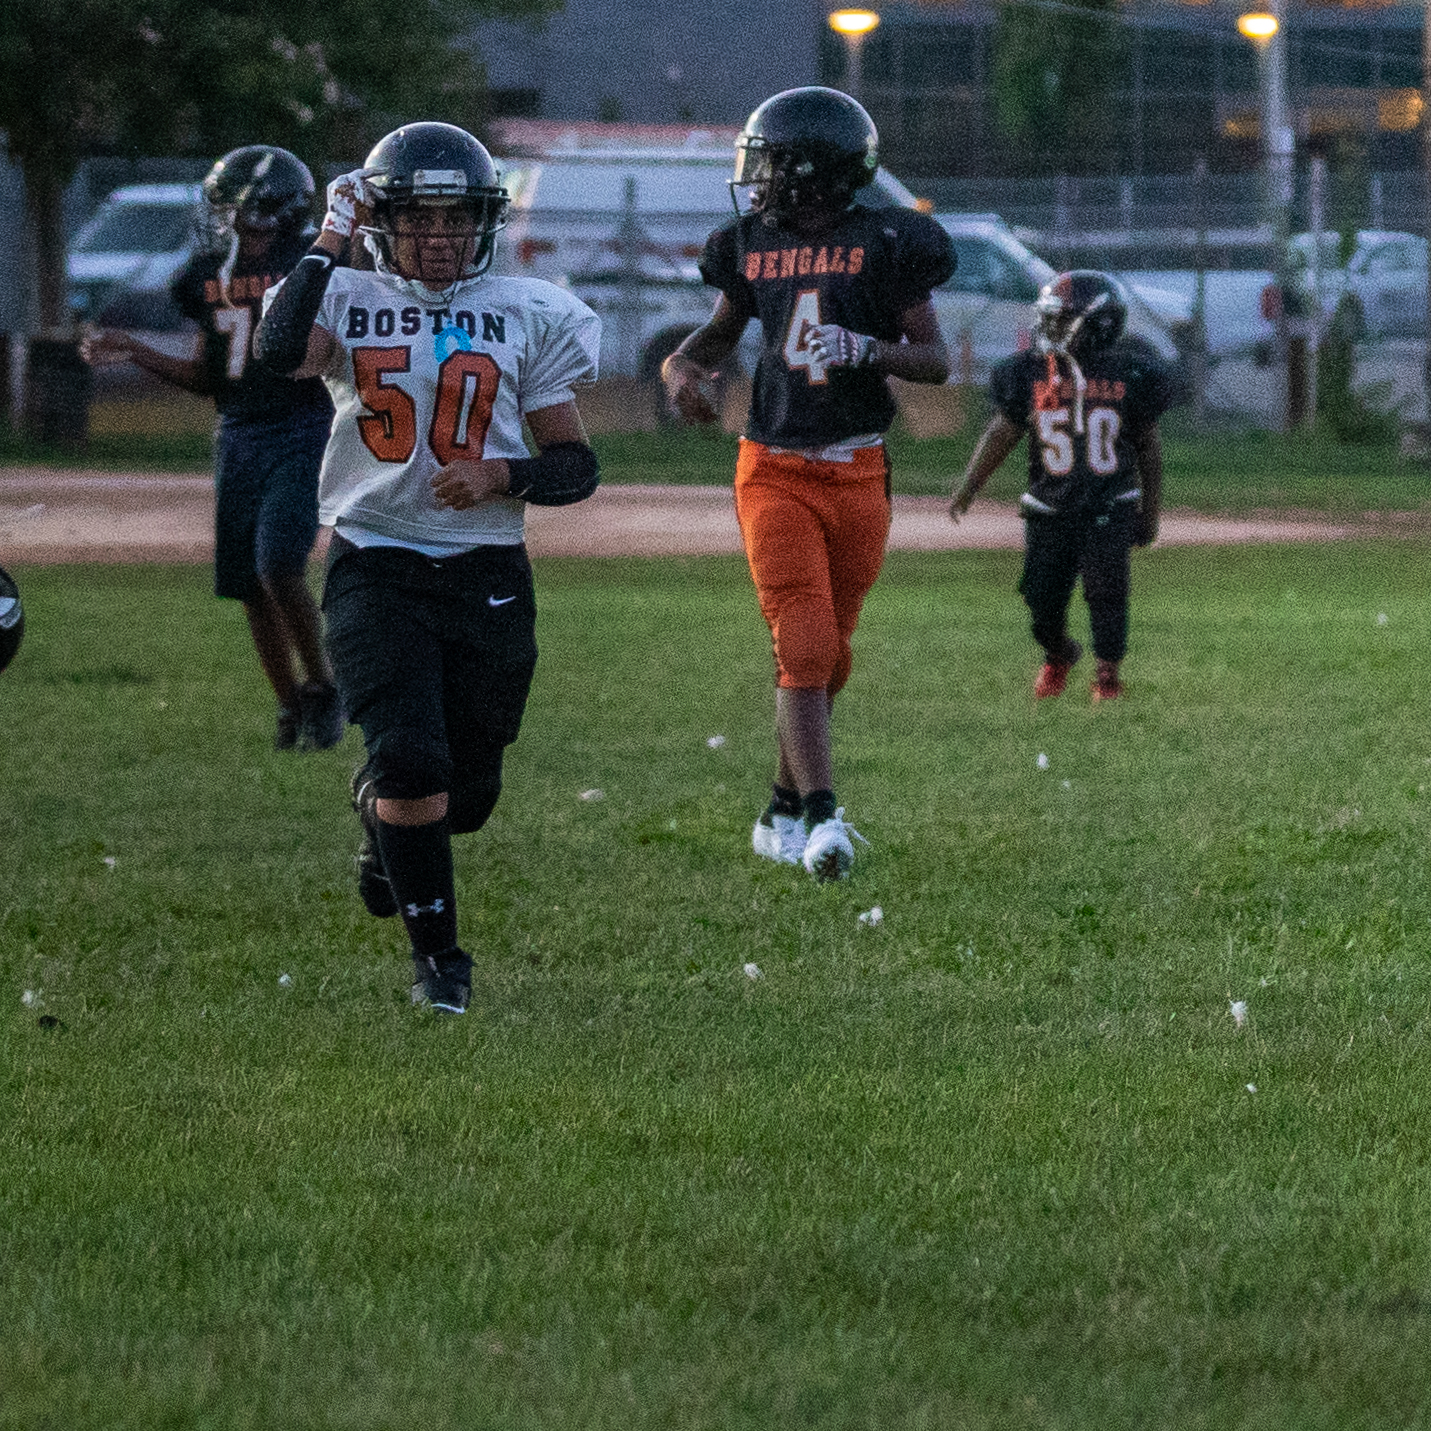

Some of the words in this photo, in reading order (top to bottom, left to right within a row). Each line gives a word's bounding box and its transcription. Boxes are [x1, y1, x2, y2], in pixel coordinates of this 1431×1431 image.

[745, 246, 865, 281] BENGALS
[346, 305, 506, 344] BOSTON
[782, 288, 829, 386] 4
[352, 344, 502, 467] 50
[1038, 407, 1121, 476] 50
